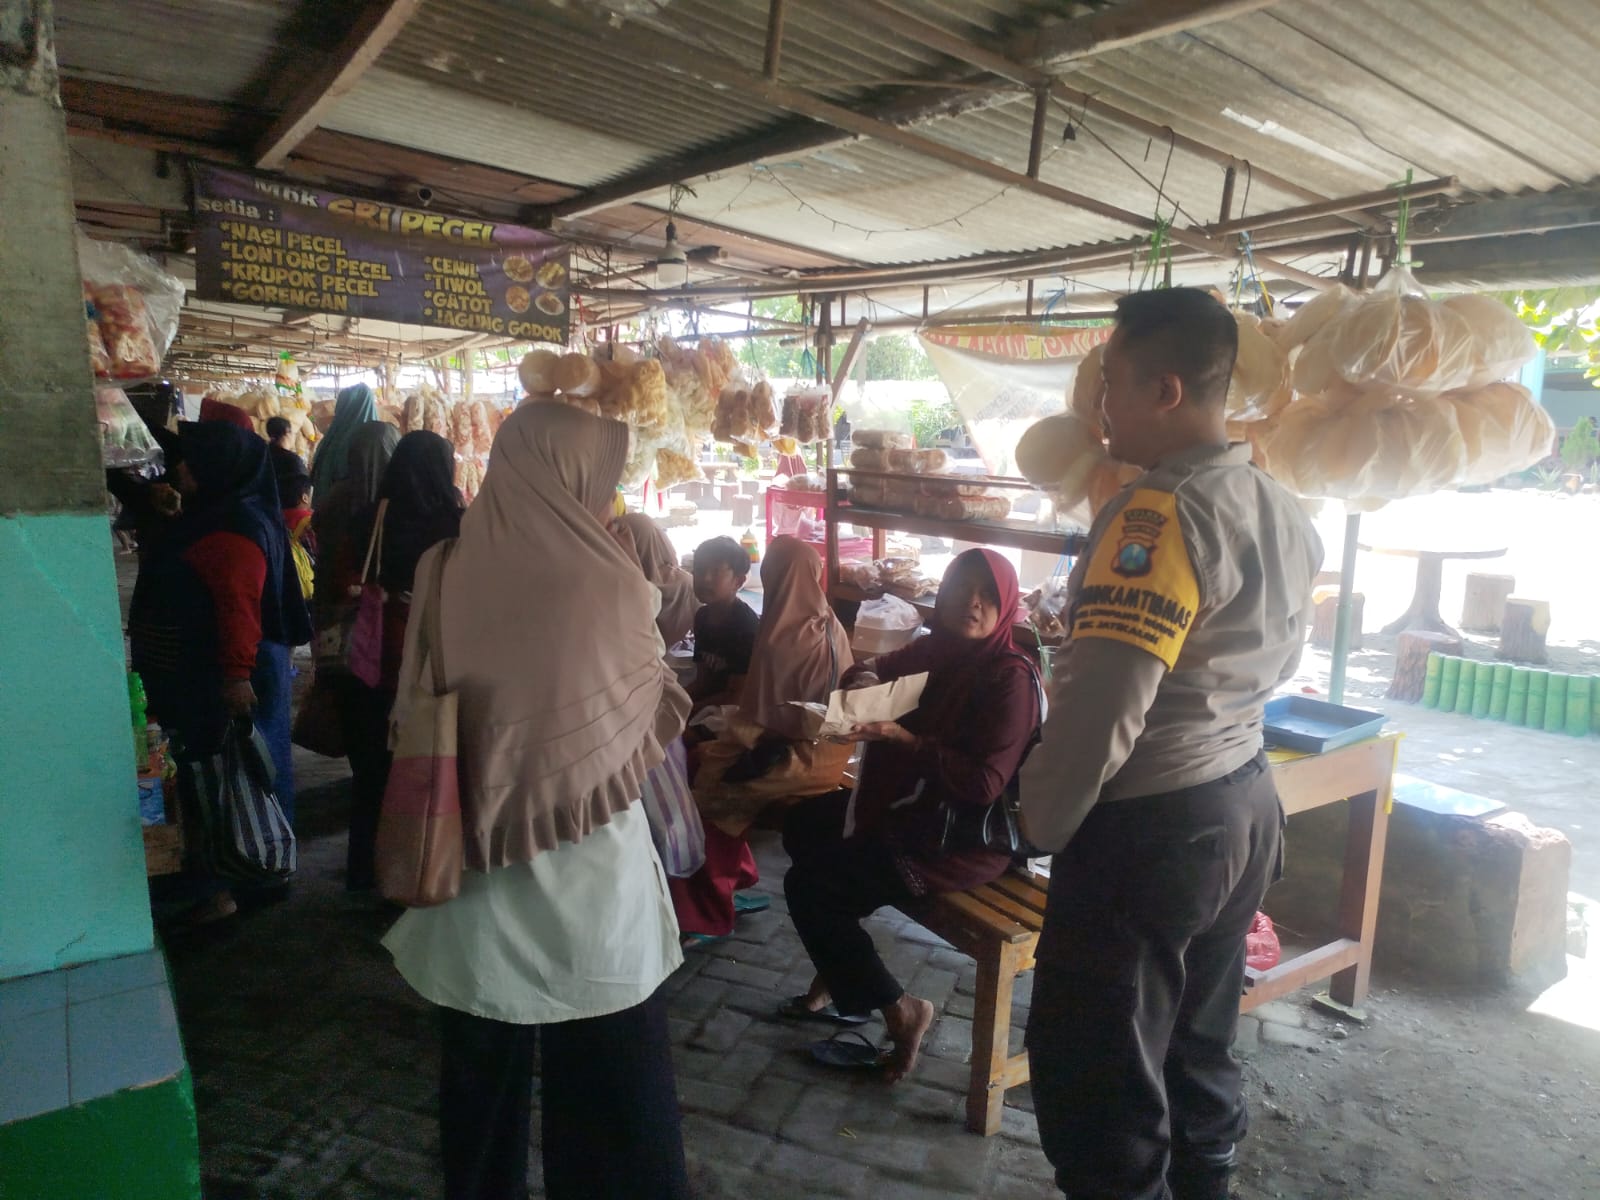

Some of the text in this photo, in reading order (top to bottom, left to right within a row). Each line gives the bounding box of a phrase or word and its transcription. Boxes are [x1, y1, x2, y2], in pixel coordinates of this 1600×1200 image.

[197, 197, 261, 219] sedia
[230, 221, 346, 256] NASI PECEL
[231, 242, 392, 281] LONTONG PECEL
[231, 261, 379, 297] KRUPOK PECEL
[433, 273, 487, 297] TIWOL
[231, 281, 348, 311] GORENGAN
[432, 291, 493, 315] GATOT
[434, 309, 563, 343] JAGUNG GODOK
